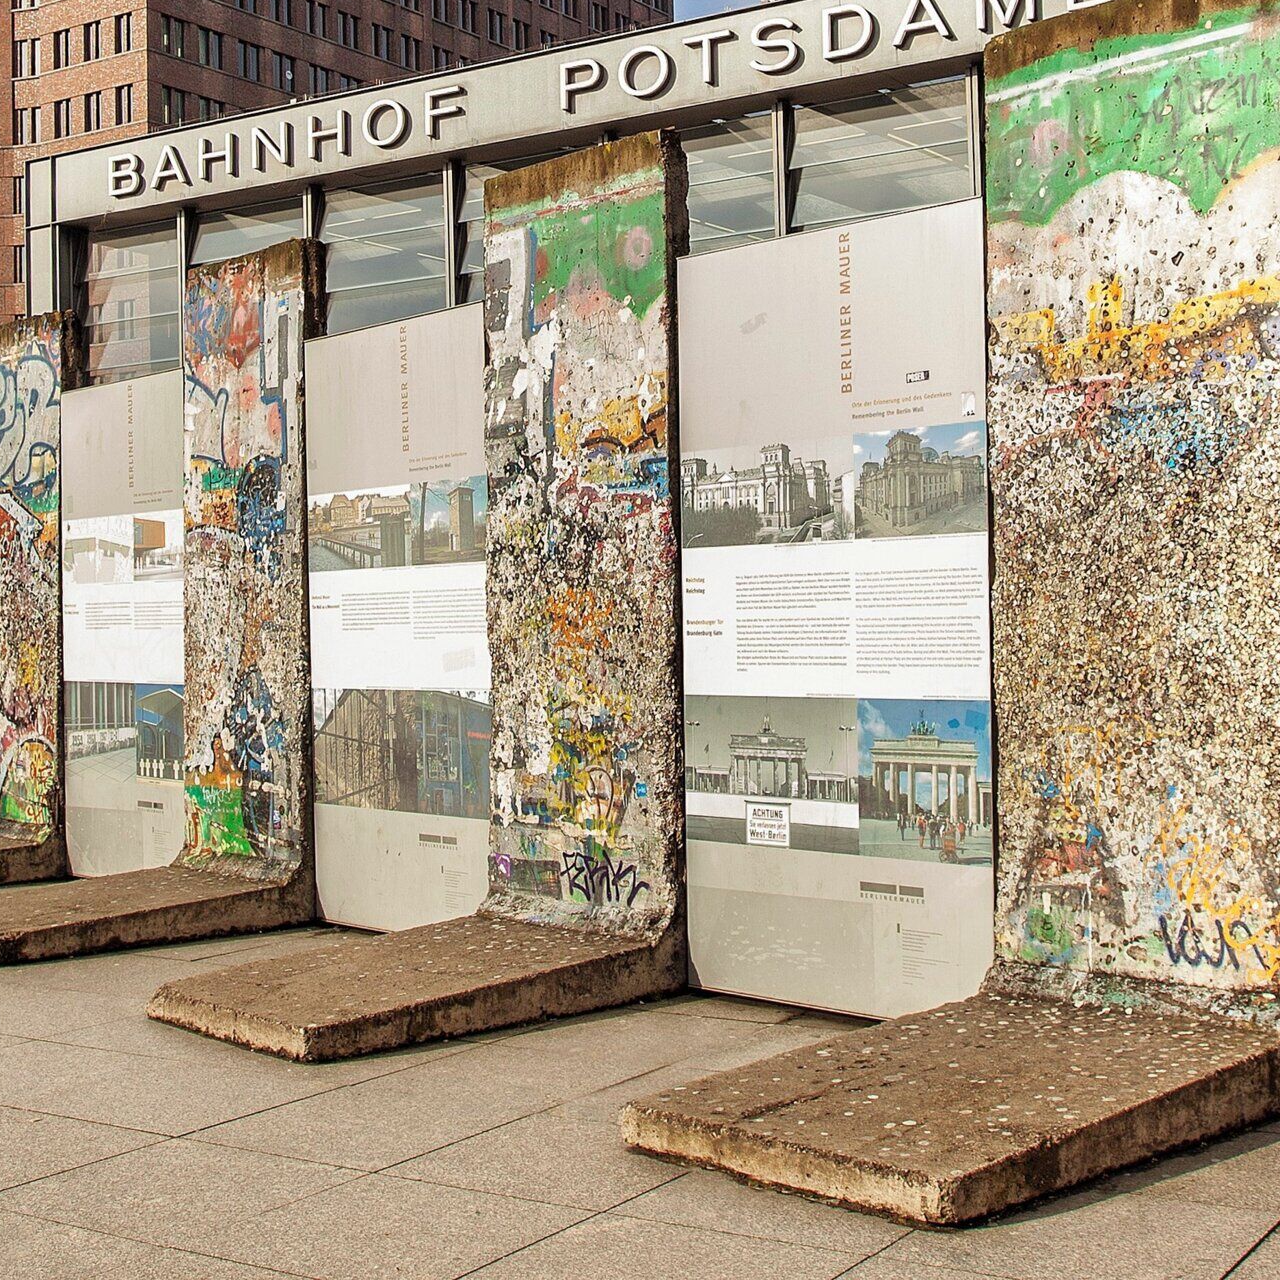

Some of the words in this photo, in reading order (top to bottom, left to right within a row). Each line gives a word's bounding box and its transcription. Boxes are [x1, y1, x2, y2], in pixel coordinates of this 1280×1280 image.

[108, 85, 469, 198] BAHNHOF
[838, 231, 851, 295] MAUER
[399, 325, 408, 375] MAUER
[840, 304, 853, 394] BERLINER
[401, 382, 410, 453] BERLINER
[752, 808, 784, 819] ACHTUNG
